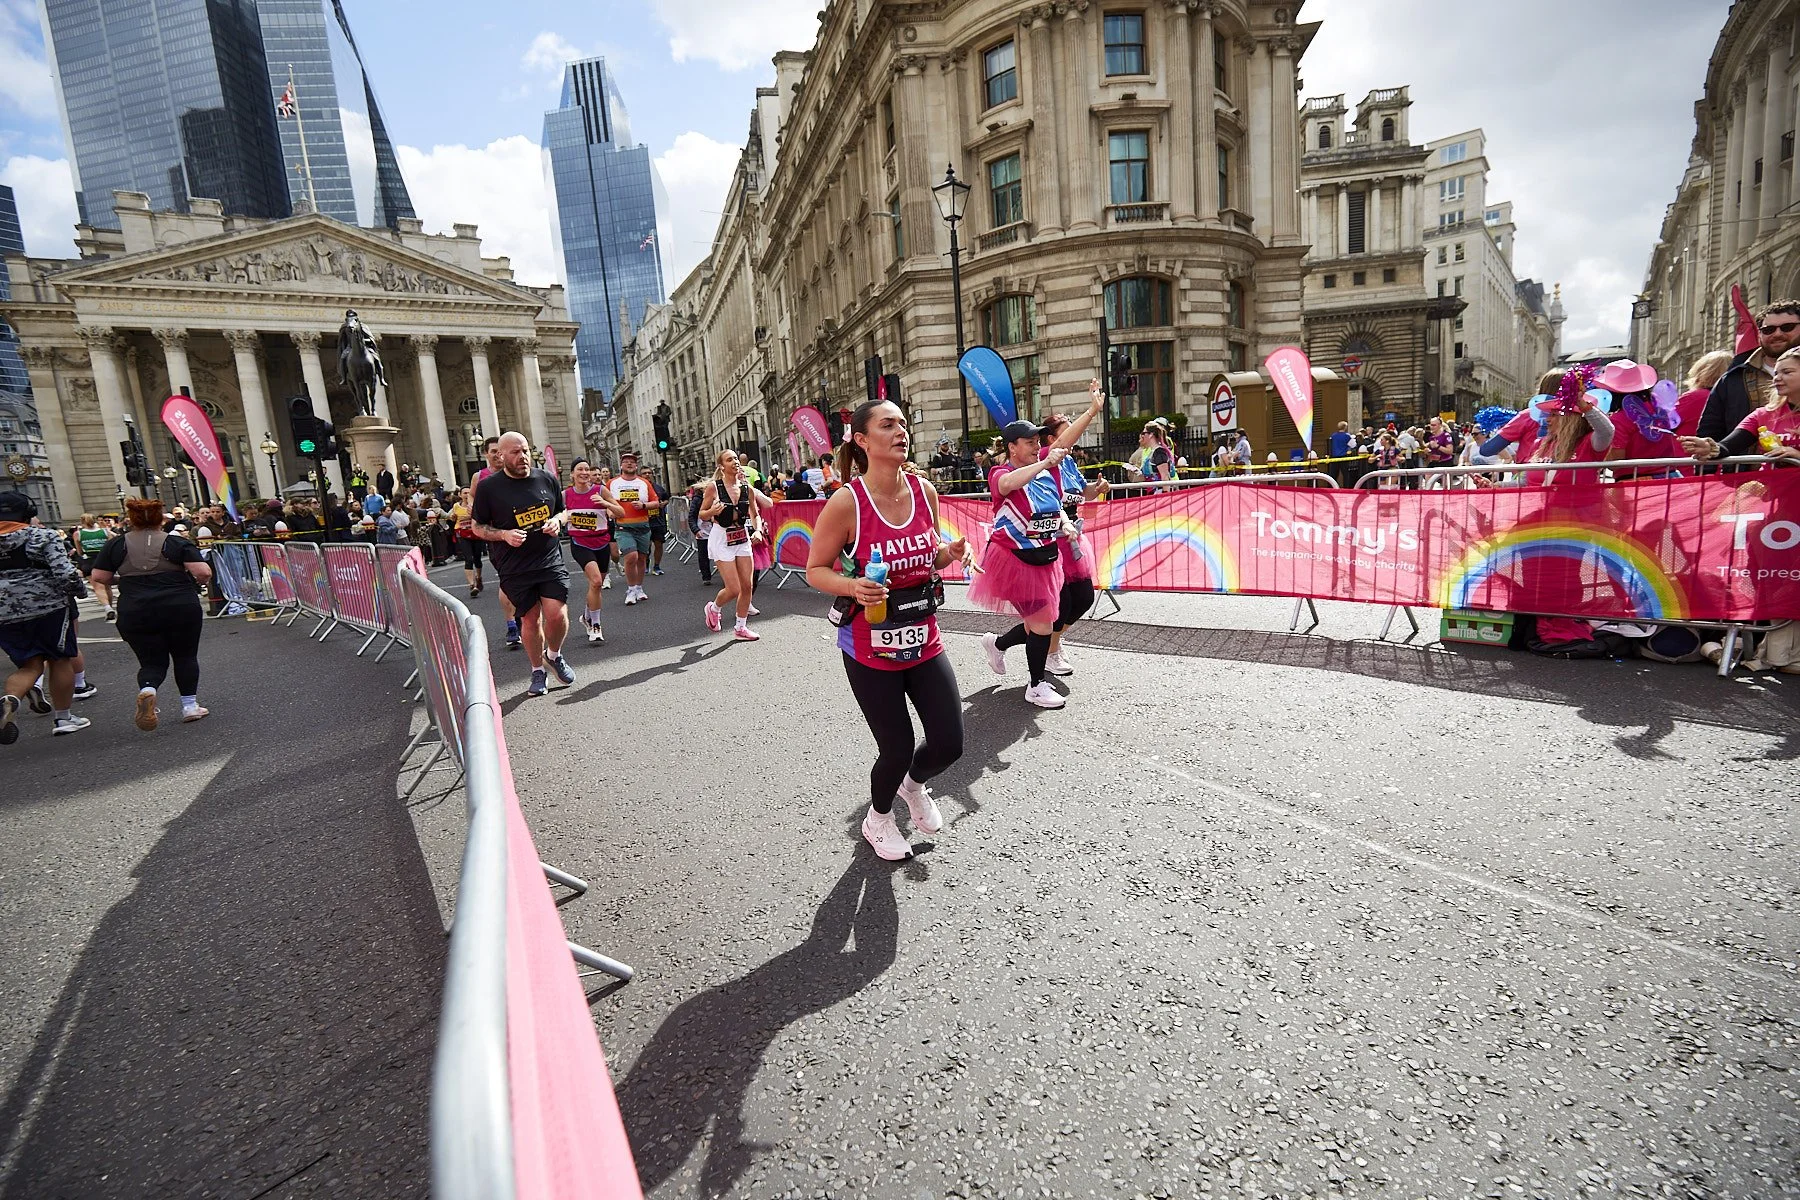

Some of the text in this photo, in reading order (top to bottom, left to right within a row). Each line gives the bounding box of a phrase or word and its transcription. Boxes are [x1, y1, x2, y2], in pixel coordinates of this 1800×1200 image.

[519, 508, 548, 524] 13794
[573, 517, 596, 525] 14036
[1033, 520, 1057, 530] 9495
[1250, 511, 1418, 555] Tommy's
[1720, 512, 1800, 550] To
[870, 531, 933, 557] HAYLEY
[1251, 548, 1268, 557] The
[1270, 550, 1323, 562] pregnancy
[1344, 556, 1371, 569] baby
[1375, 560, 1416, 572] charity
[1716, 566, 1751, 577] The
[881, 627, 924, 645] 9135
